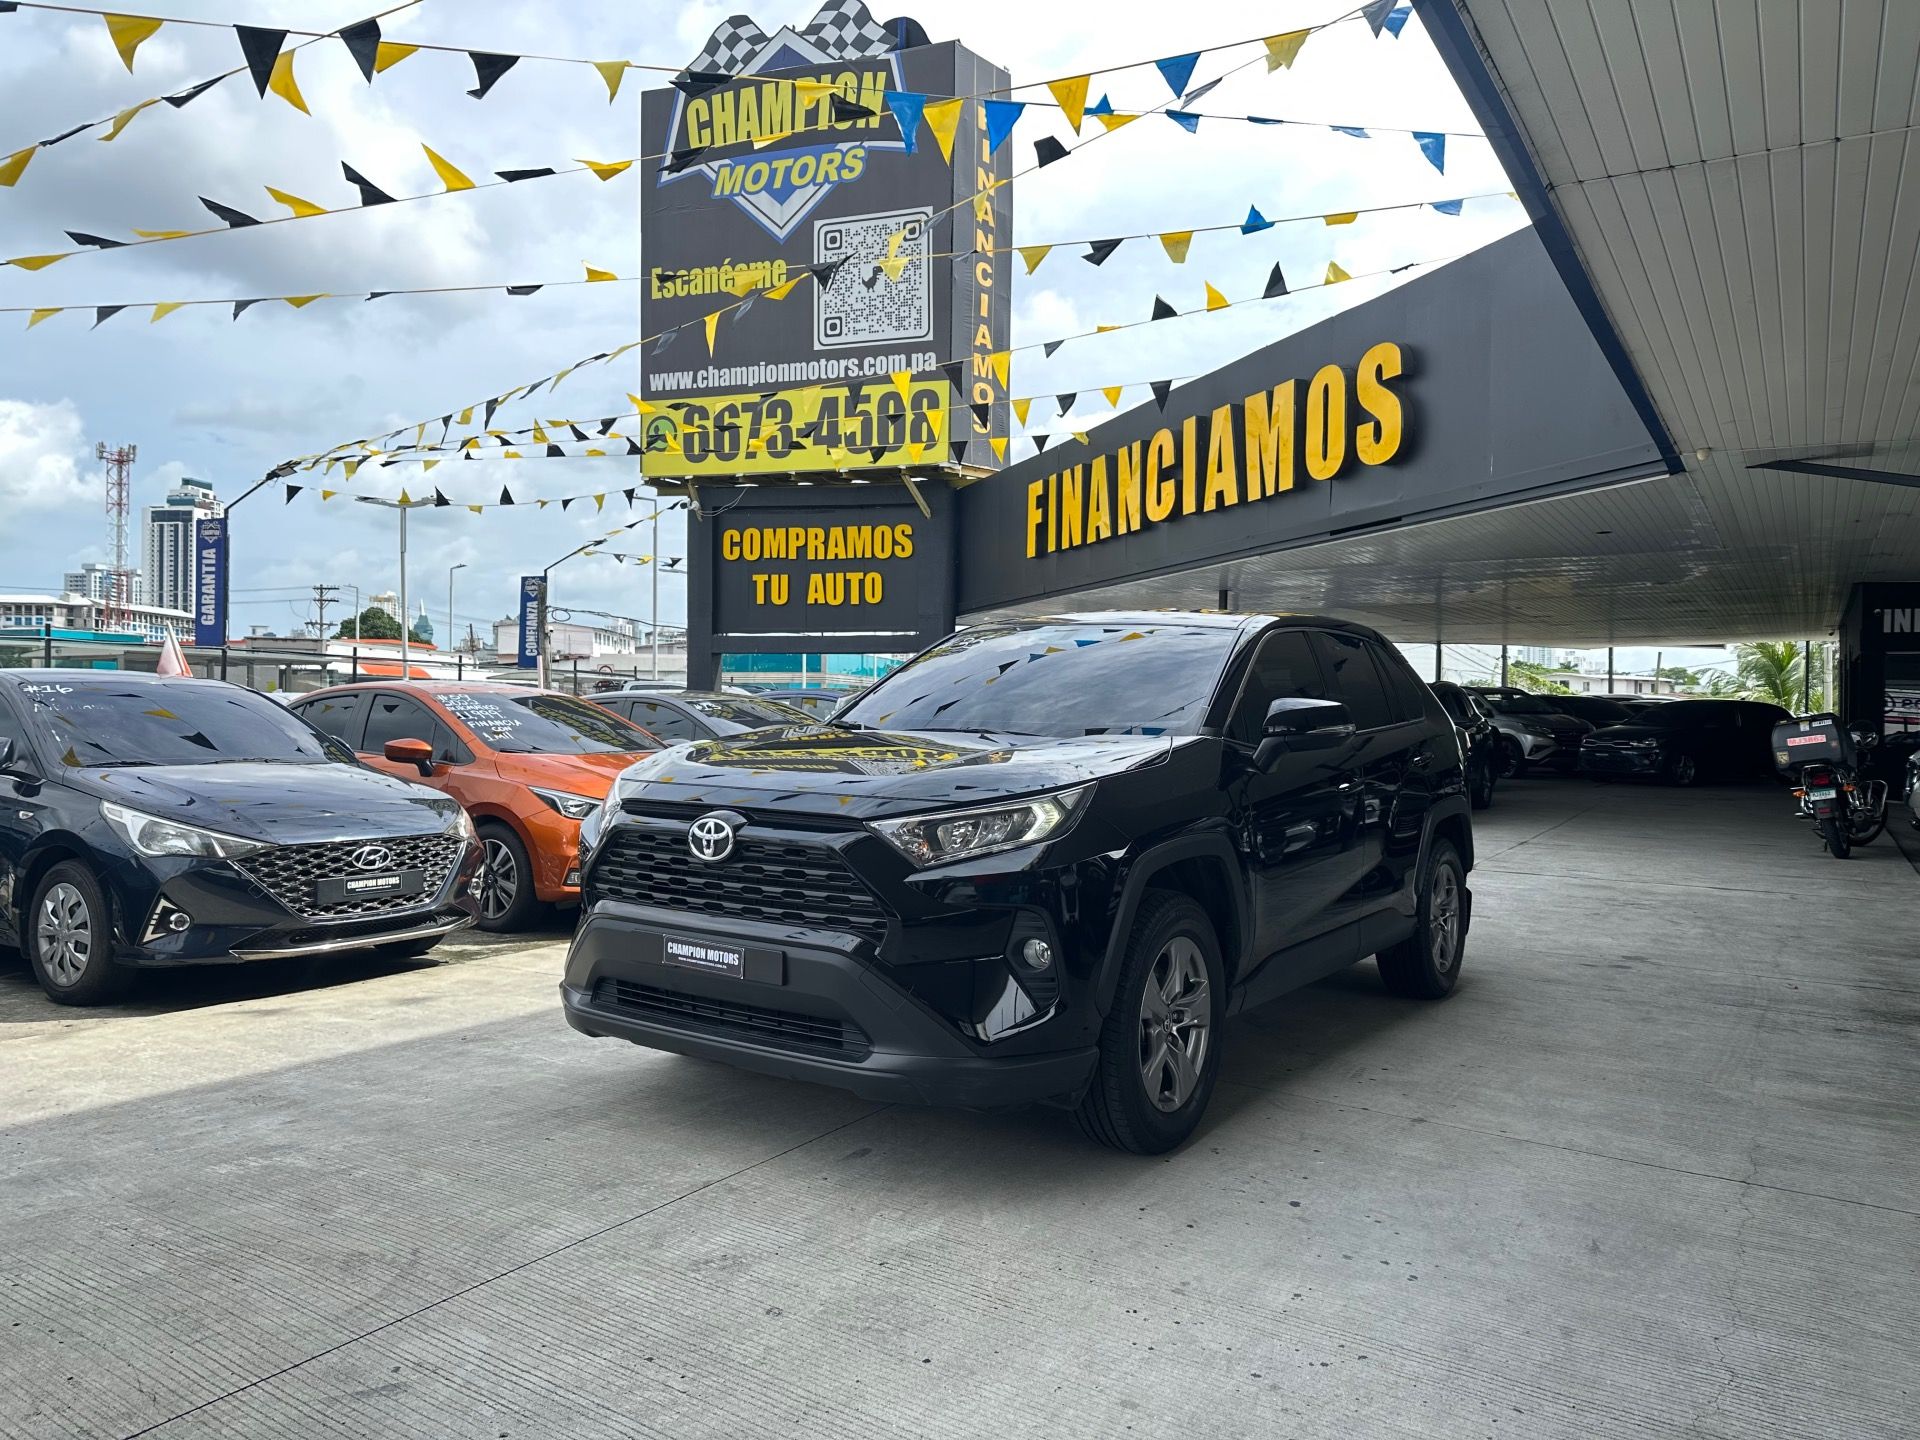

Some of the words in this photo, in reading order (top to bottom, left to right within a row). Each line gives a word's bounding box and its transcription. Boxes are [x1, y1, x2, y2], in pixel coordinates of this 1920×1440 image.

[686, 71, 887, 150] CHAMPION
[713, 147, 867, 197] MOTORS
[651, 257, 787, 300] Escanéme
[650, 351, 937, 392] www.championmotors.com.pa
[1026, 341, 1403, 559] FINANCIAMOS
[722, 523, 914, 561] COMPRAMOS
[201, 547, 216, 626] GARANTIA
[752, 574, 789, 606] TU
[806, 571, 883, 606] AUTO
[525, 600, 539, 657] CONFIANZA
[23, 684, 74, 695] #16
[347, 879, 377, 890] CHAMPION
[667, 942, 706, 960] CHAMPION
[707, 948, 739, 966] MOTORS
